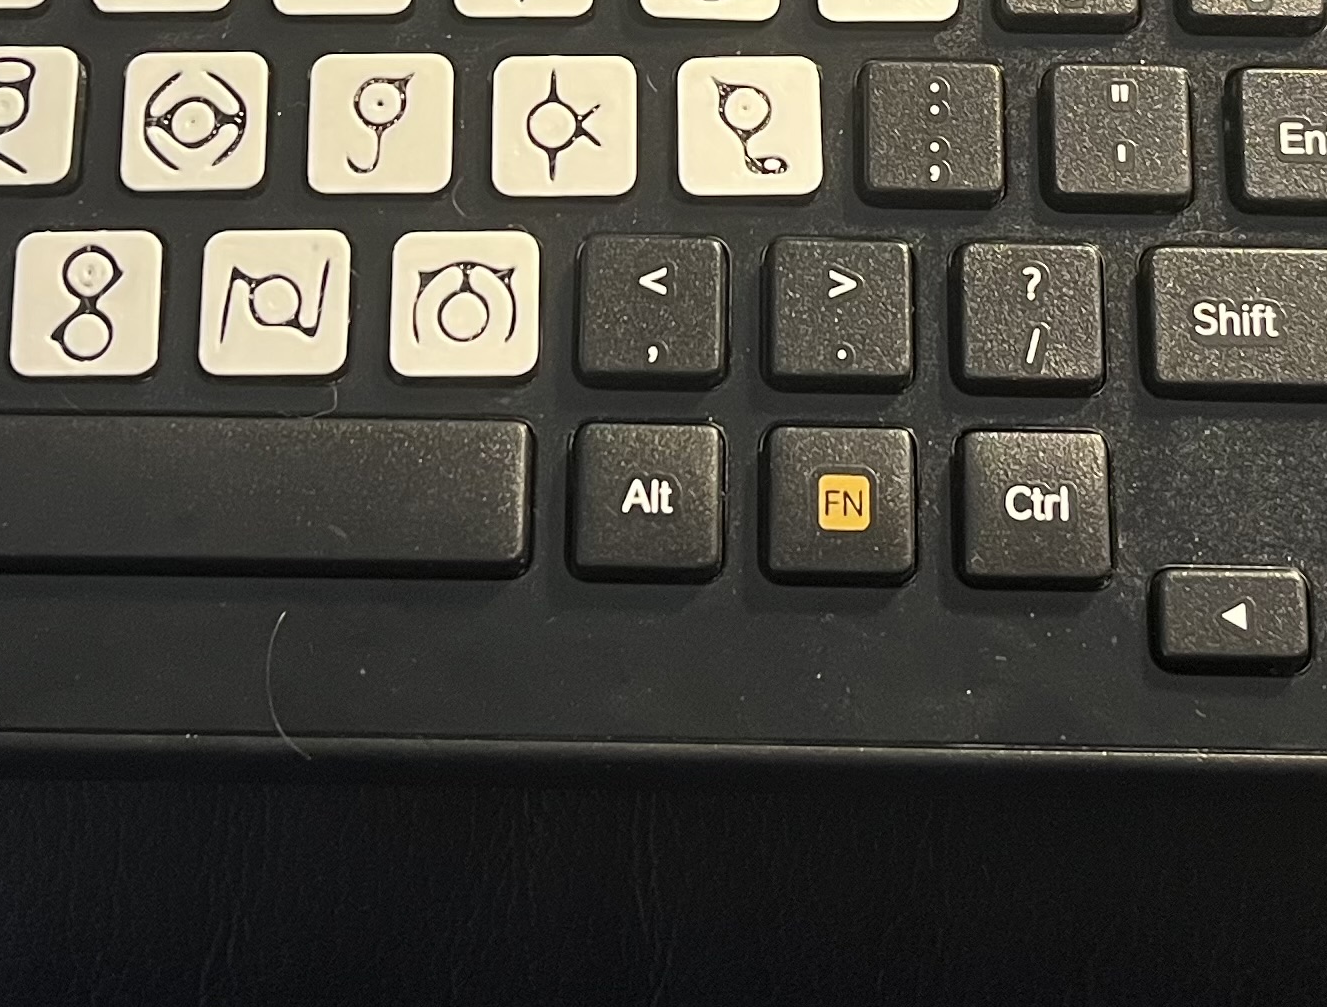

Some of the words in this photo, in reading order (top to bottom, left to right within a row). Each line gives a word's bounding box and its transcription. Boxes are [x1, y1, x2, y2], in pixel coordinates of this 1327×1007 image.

[1193, 304, 1279, 338] Shift
[621, 479, 673, 514] Alt
[825, 491, 864, 516] FN
[1004, 485, 1069, 522] Ctrl
